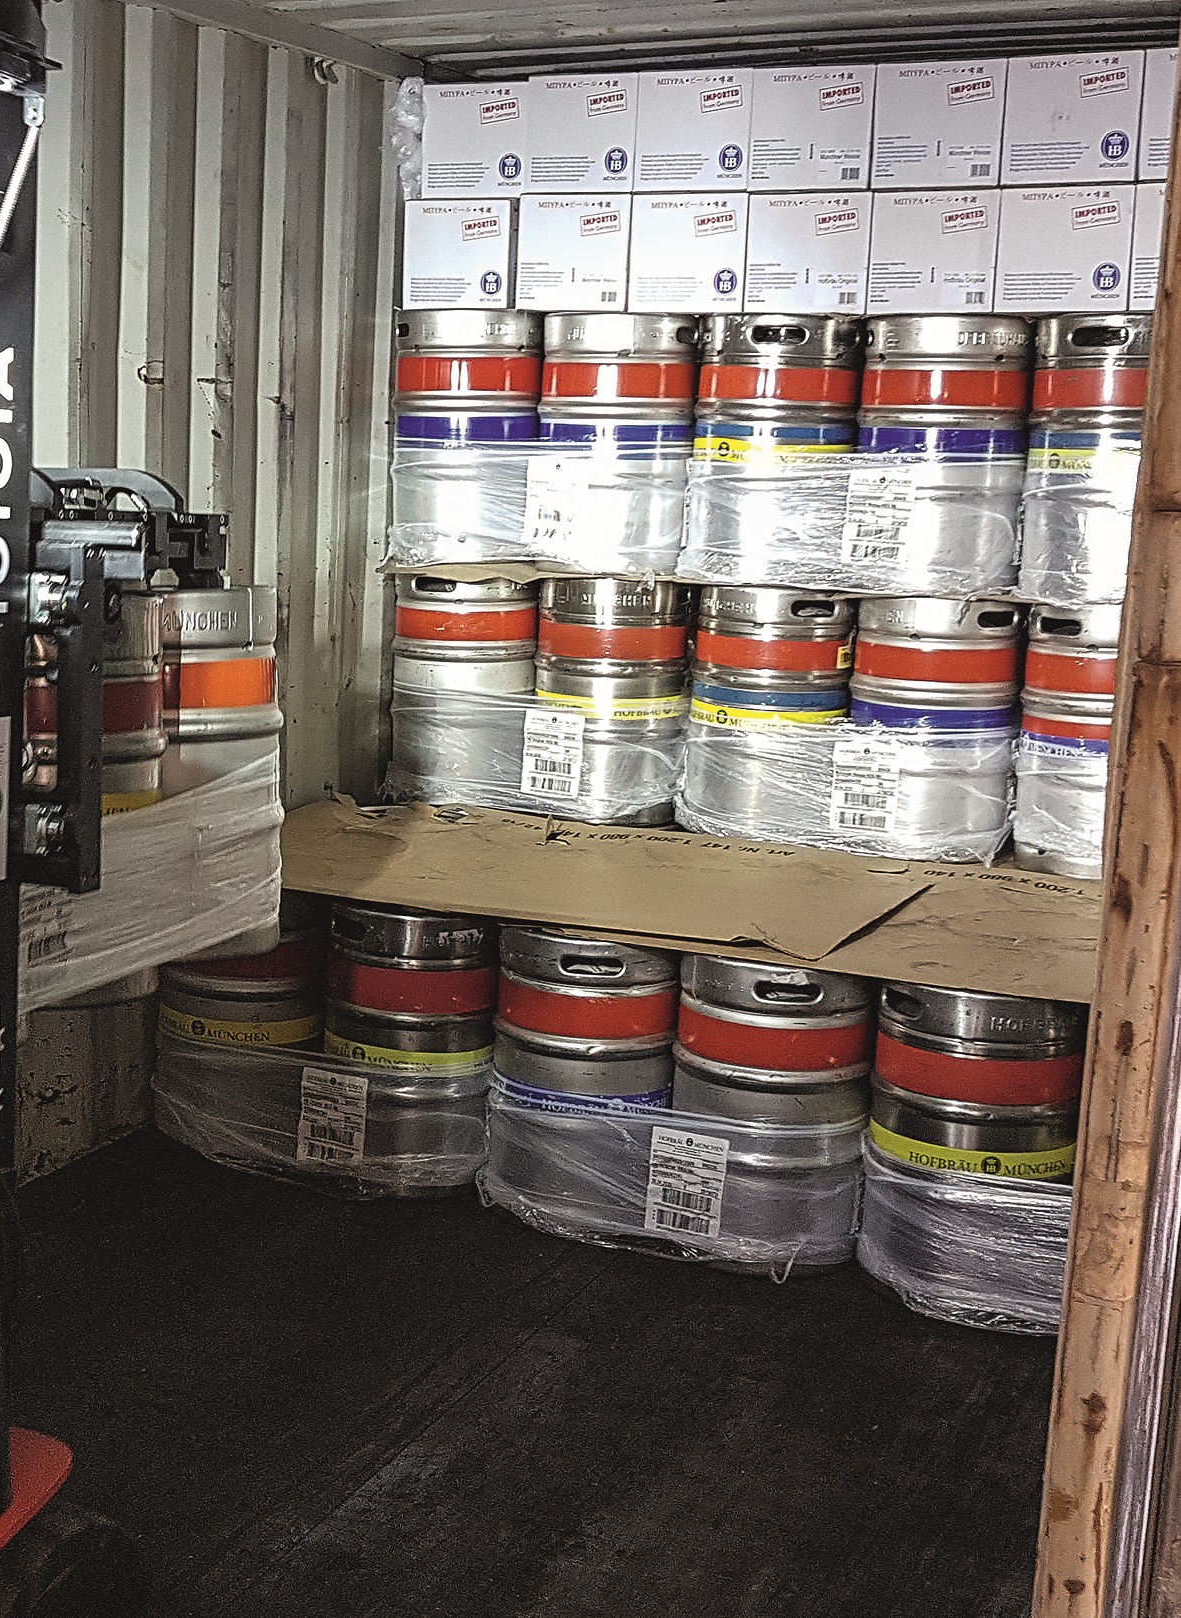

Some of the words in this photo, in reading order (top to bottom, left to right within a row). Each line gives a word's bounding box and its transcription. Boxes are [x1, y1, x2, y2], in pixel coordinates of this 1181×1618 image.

[1082, 71, 1126, 87] IMPORTED
[822, 86, 861, 100] IMPORTED
[950, 80, 991, 95] IMPORTED
[589, 93, 624, 106] IMPORTED
[702, 88, 740, 102] IMPORTED
[482, 101, 516, 114] IMPORTED
[818, 212, 856, 225] IMPORTED
[944, 210, 984, 223] IMPORTED
[1074, 205, 1117, 220] IMPORTED
[464, 220, 498, 231] IMPORTED
[582, 215, 618, 226] IMPORTED
[697, 213, 734, 227] IMPORTED
[647, 836, 692, 845] 1.200
[700, 841, 731, 851] 147
[766, 848, 796, 856] Art.
[1034, 881, 1085, 896] 1.200
[909, 1151, 978, 1172] HOFBRÄU
[1004, 1159, 1067, 1176] MÜNCHEN
